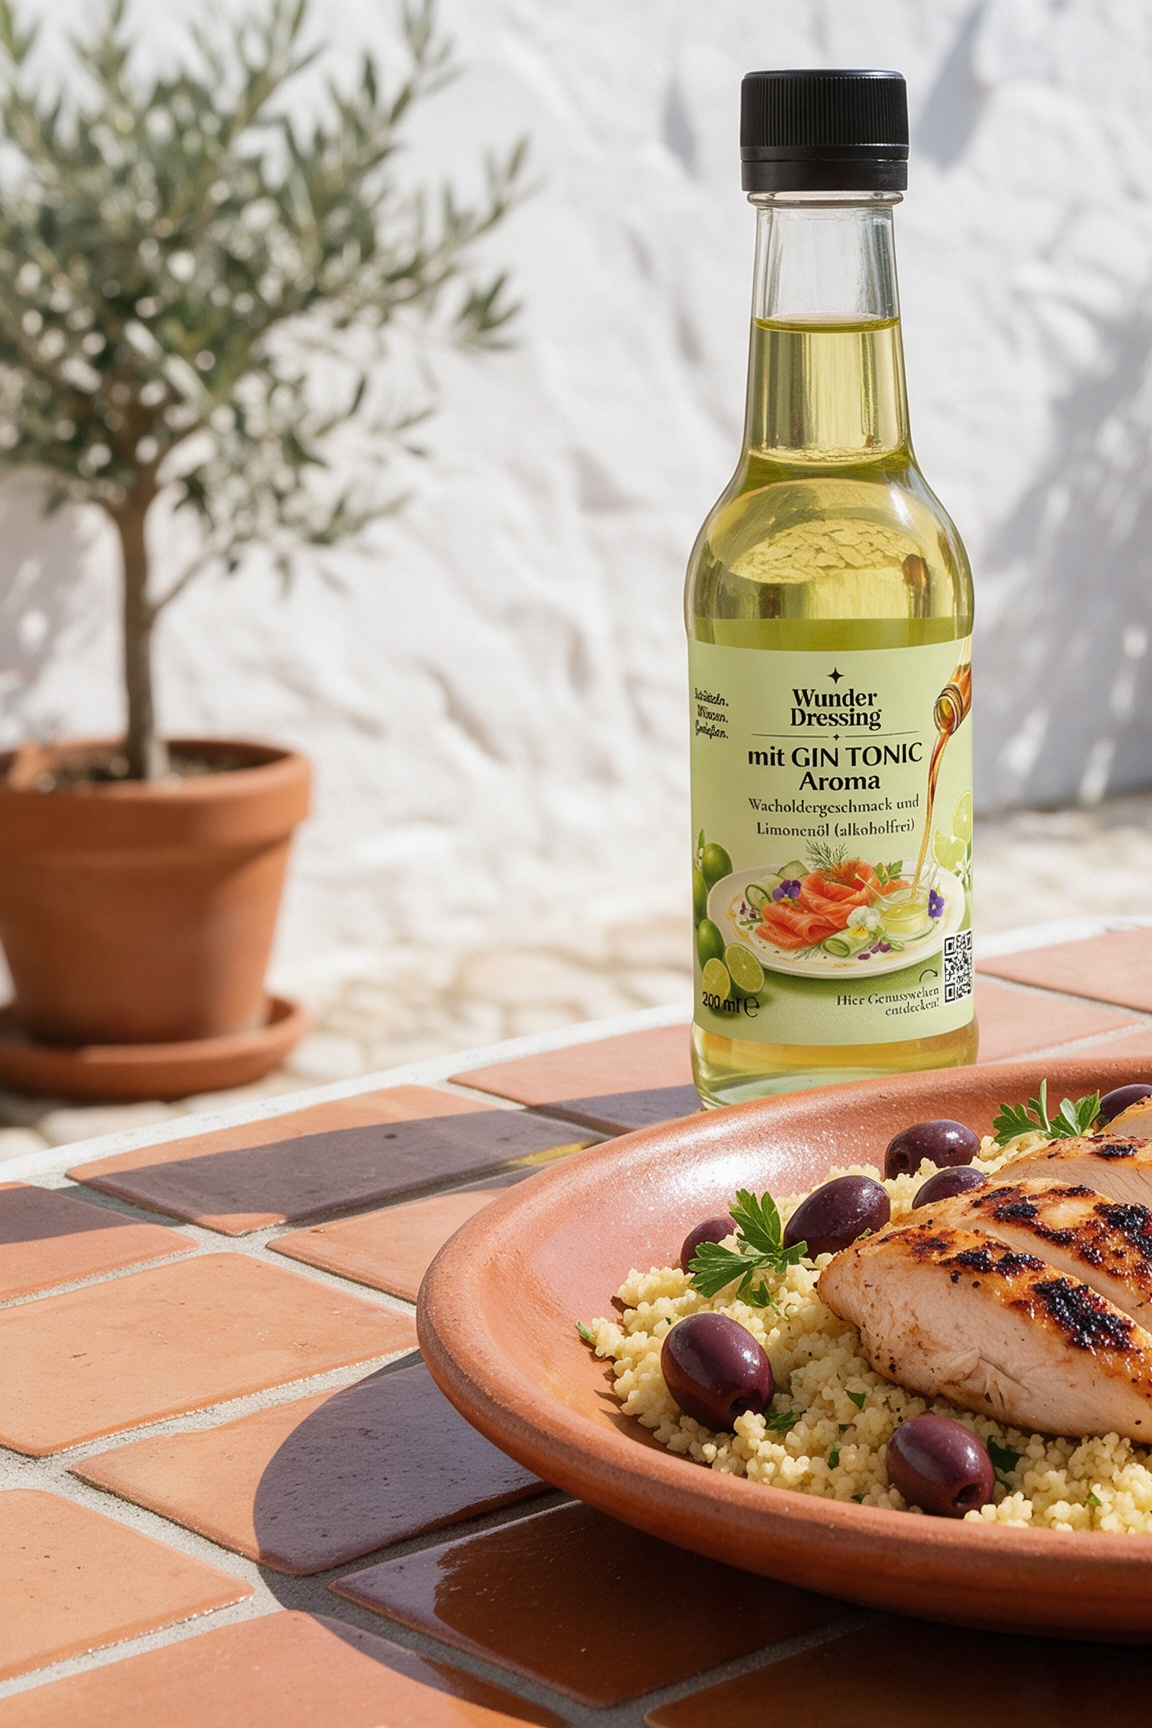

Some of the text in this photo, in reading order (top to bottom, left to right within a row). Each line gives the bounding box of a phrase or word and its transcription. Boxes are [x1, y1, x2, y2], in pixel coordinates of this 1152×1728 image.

[792, 688, 878, 707] Wunder
[790, 708, 882, 731] Dressing
[748, 742, 923, 767] mit GIN TONIC
[799, 771, 881, 791] Aroma
[748, 793, 920, 818] Wacholdergeschmack und
[756, 818, 915, 838] Limonenöl (alkoholfrei)
[702, 991, 721, 1009] 200
[836, 995, 865, 1006] Hier
